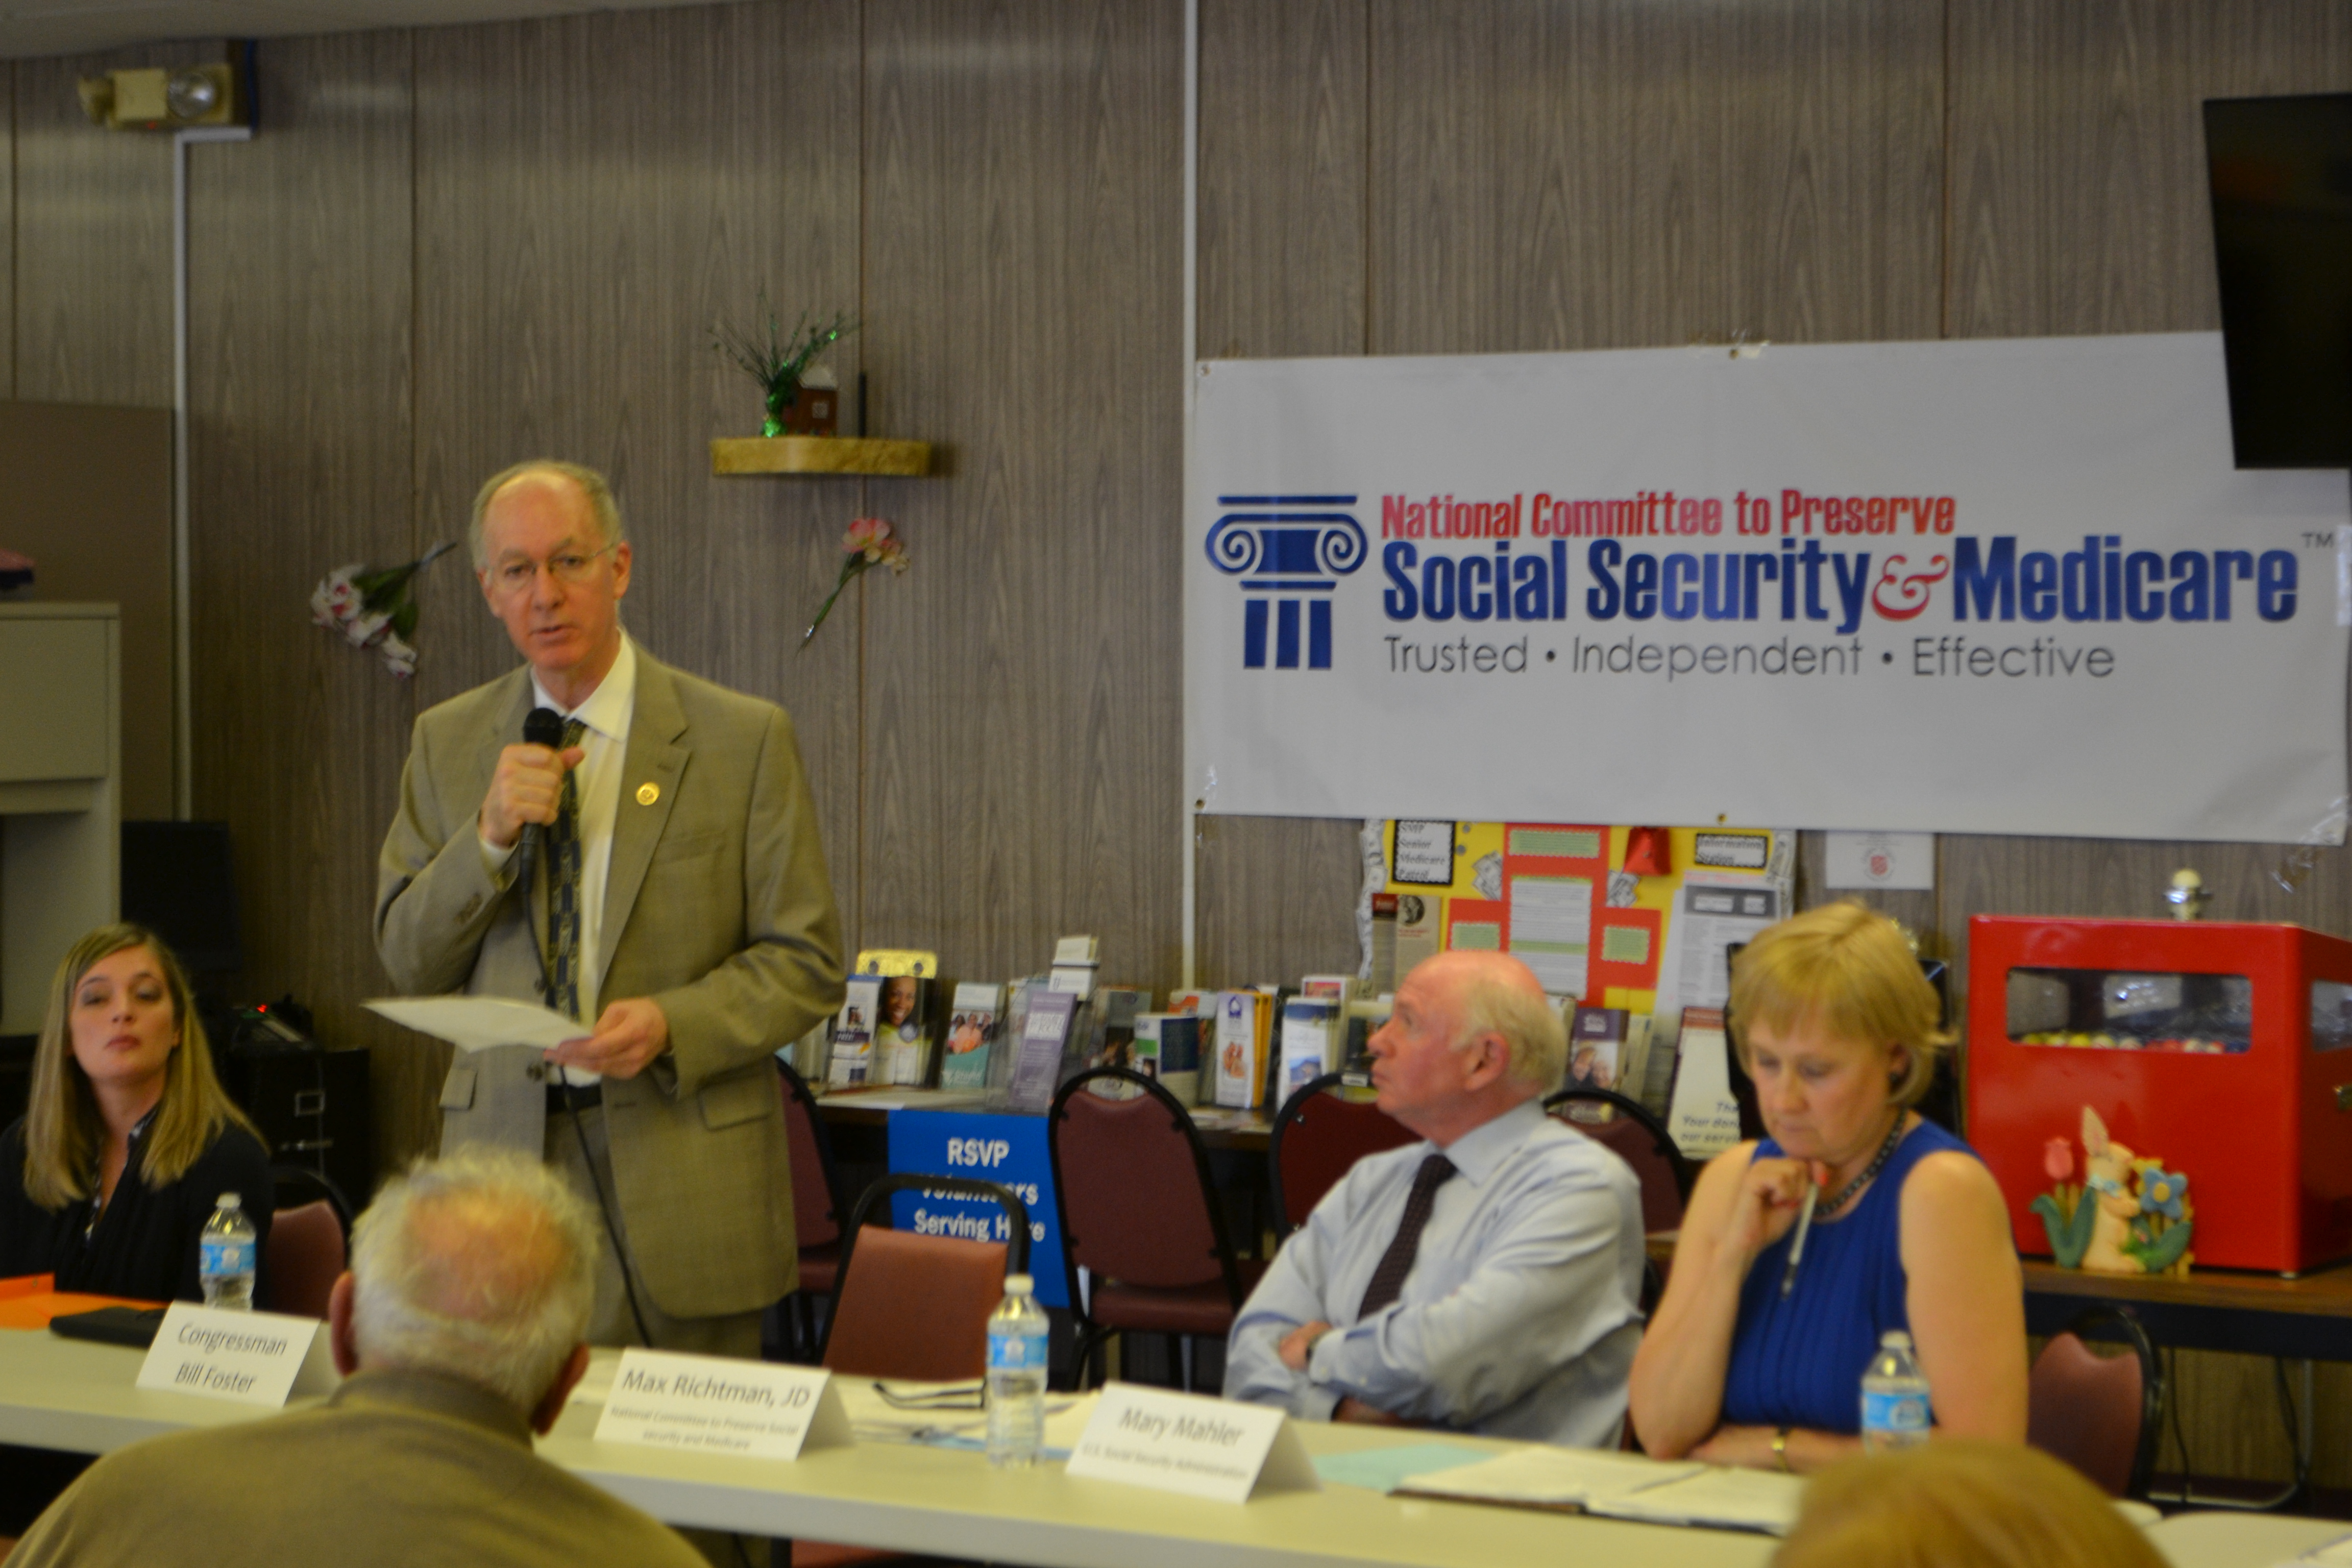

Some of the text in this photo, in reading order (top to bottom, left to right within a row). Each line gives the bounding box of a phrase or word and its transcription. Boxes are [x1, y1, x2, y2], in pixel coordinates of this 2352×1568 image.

[1382, 489, 1955, 539] National Committee to Preserve
[1383, 540, 1566, 622] Social
[1587, 537, 1870, 634] Security
[1872, 554, 1949, 620] &
[1953, 535, 2298, 622] Medicare
[1384, 634, 2114, 682] Trusted Independent Effective
[947, 1137, 1010, 1168] RSVP
[914, 1208, 1046, 1242] Serving He
[178, 1321, 287, 1356] Congressman
[175, 1361, 257, 1393] Bill Foster
[622, 1369, 812, 1409] Max Richtman, JD
[1118, 1406, 1245, 1447] Mary Mahler
